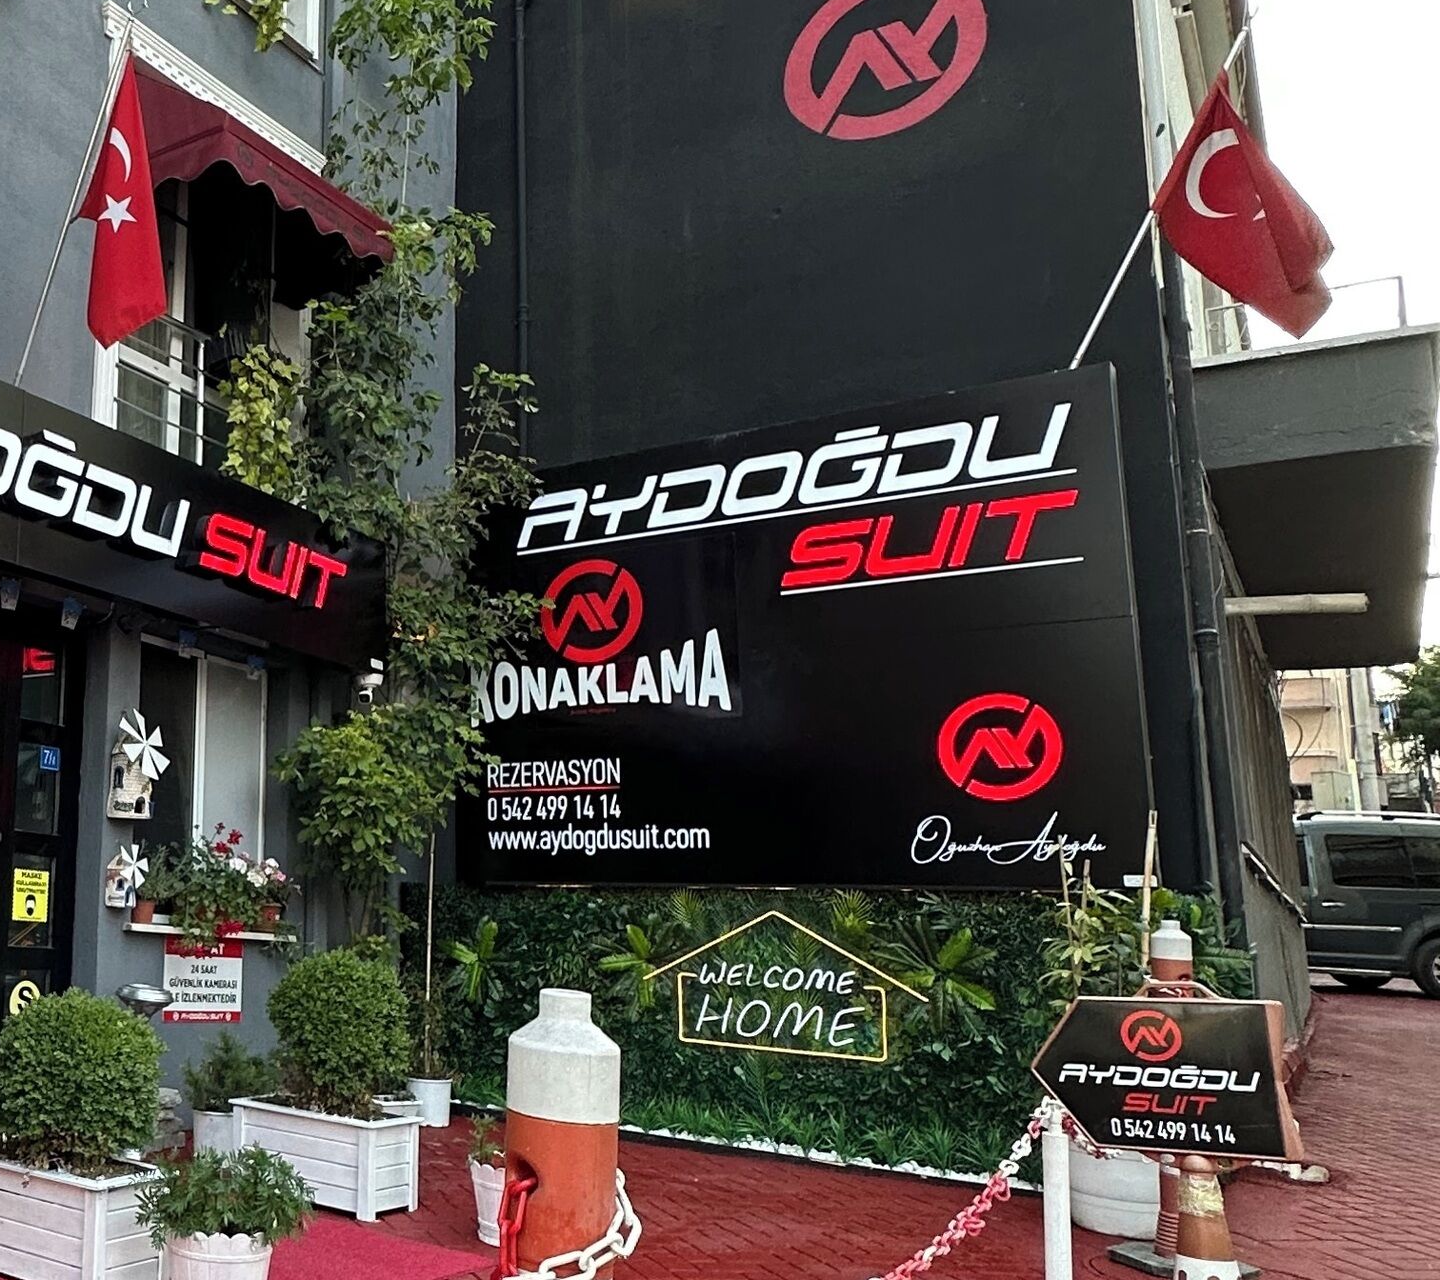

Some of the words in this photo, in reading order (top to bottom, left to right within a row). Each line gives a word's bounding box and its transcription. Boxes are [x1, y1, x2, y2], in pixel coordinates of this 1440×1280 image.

[517, 402, 1072, 548] AYDOĞDU
[781, 489, 1079, 587] SUIT
[199, 512, 348, 609] SUIT
[471, 628, 732, 728] KONAKLAMA
[487, 757, 621, 788] REZERVASYON
[487, 797, 498, 821] 0
[502, 796, 532, 821] 542
[536, 795, 568, 820] 499
[573, 795, 594, 819] 14
[599, 794, 621, 818] 14
[488, 823, 711, 856] www.aydogdusuit.com
[191, 965, 199, 974] 24
[699, 961, 856, 995] WELCOME
[695, 994, 865, 1047] HOME
[1059, 1063, 1260, 1093] AYDOĞDU
[1122, 1093, 1217, 1115] SUIT
[1111, 1118, 1121, 1136] 0
[1124, 1119, 1155, 1139] 542
[1159, 1120, 1187, 1140] 499
[1191, 1122, 1212, 1143] 14
[1215, 1124, 1236, 1144] 14
